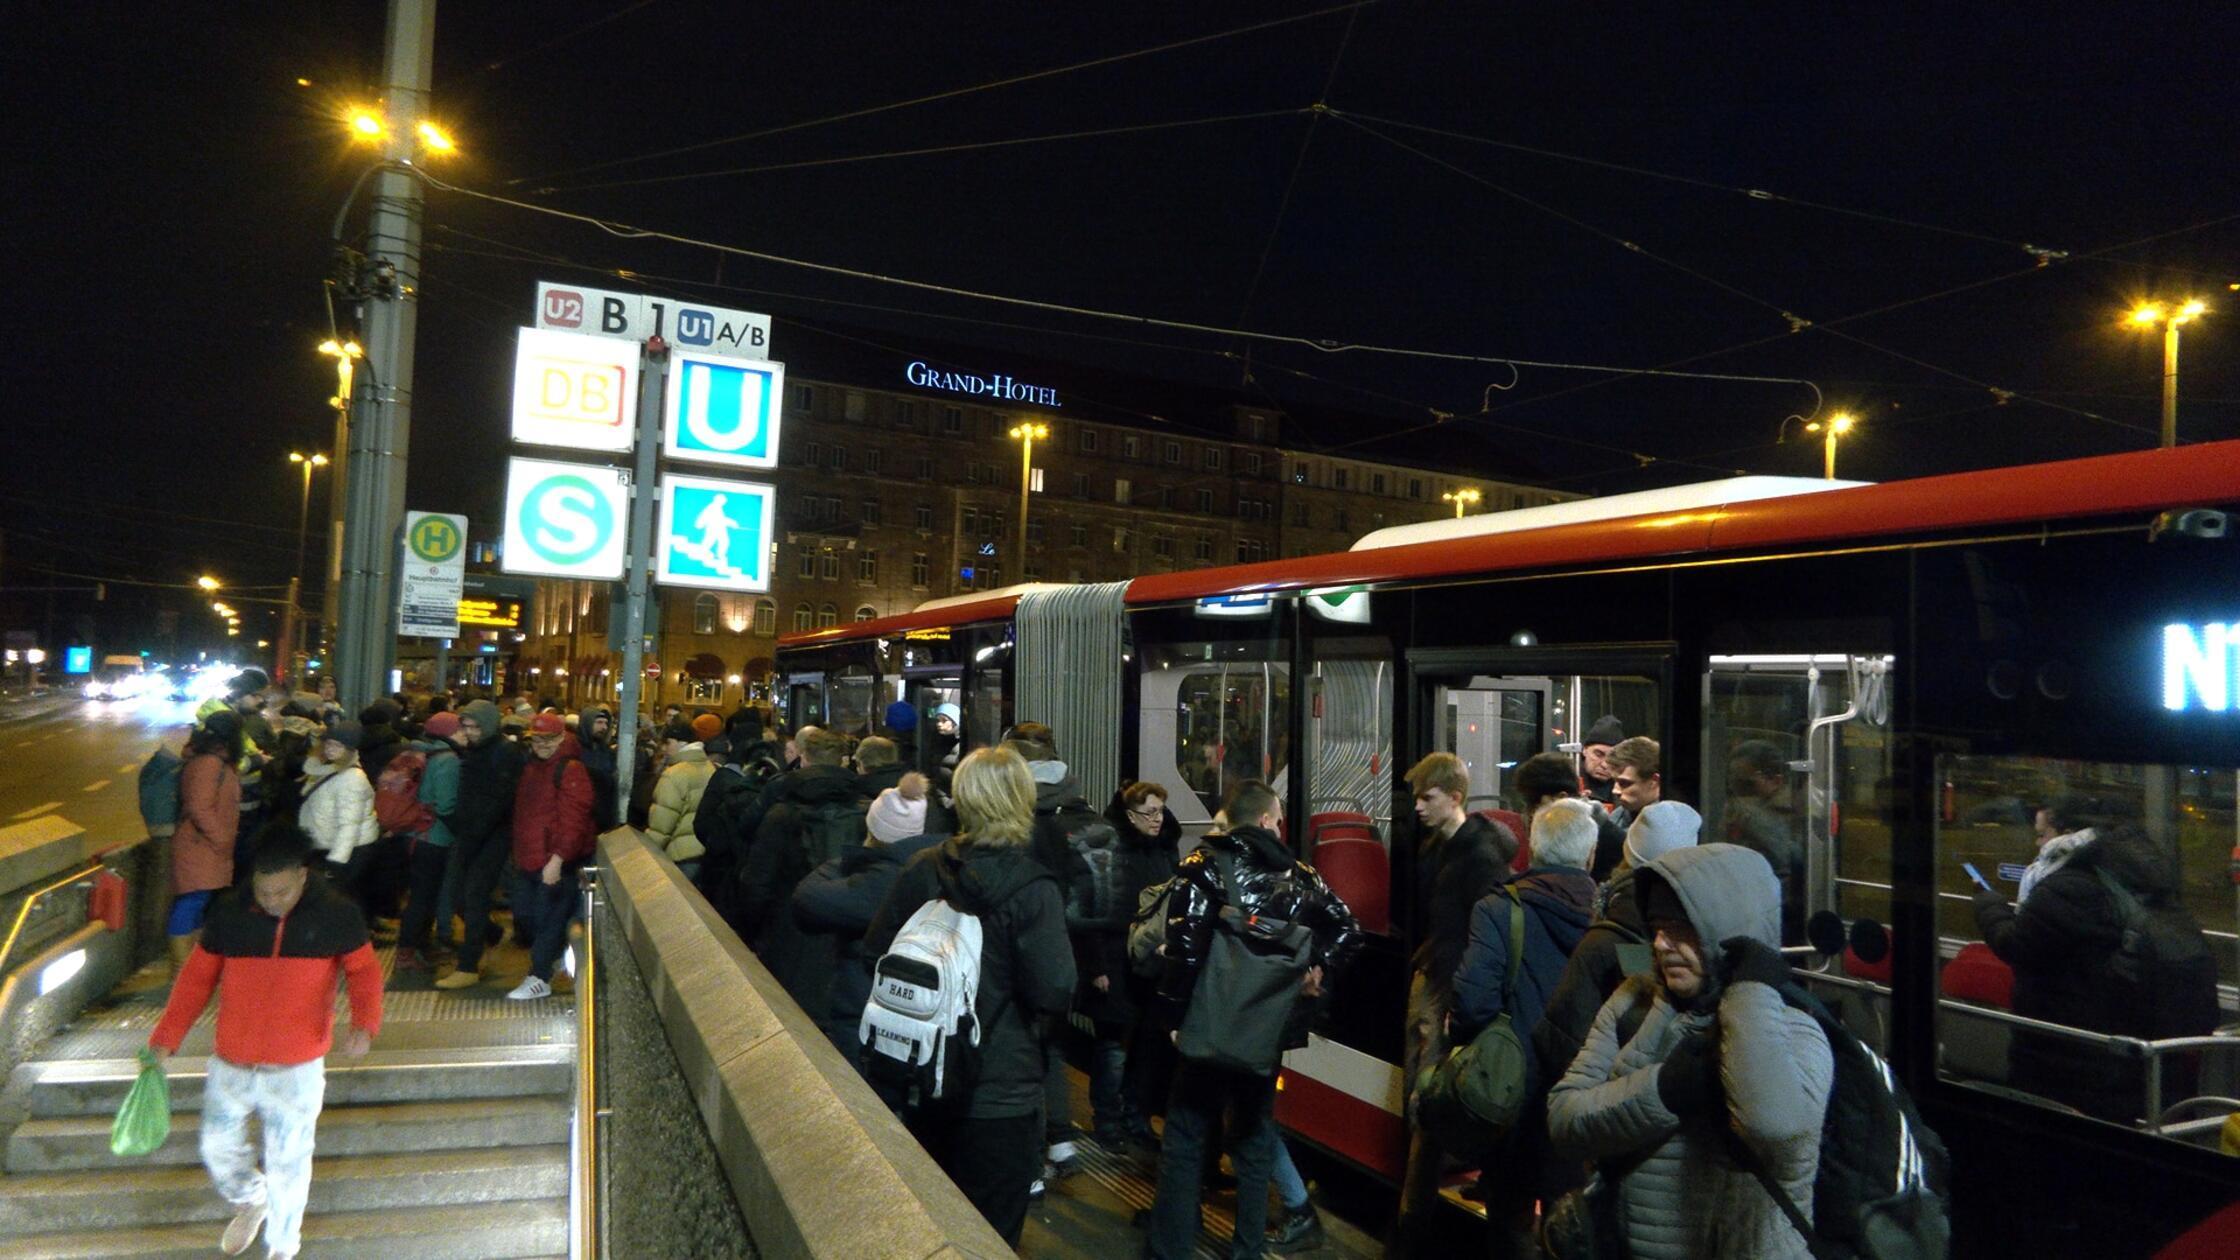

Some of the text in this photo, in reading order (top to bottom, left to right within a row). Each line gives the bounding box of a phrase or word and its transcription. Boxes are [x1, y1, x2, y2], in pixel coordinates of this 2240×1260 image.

[545, 296, 765, 348] U2 B 1 U1 A/B
[540, 367, 610, 414] DB
[687, 364, 763, 451] U
[423, 526, 449, 553] H
[536, 485, 598, 555] S
[889, 983, 915, 1001] HARD
[877, 1027, 911, 1046] LEARNING
